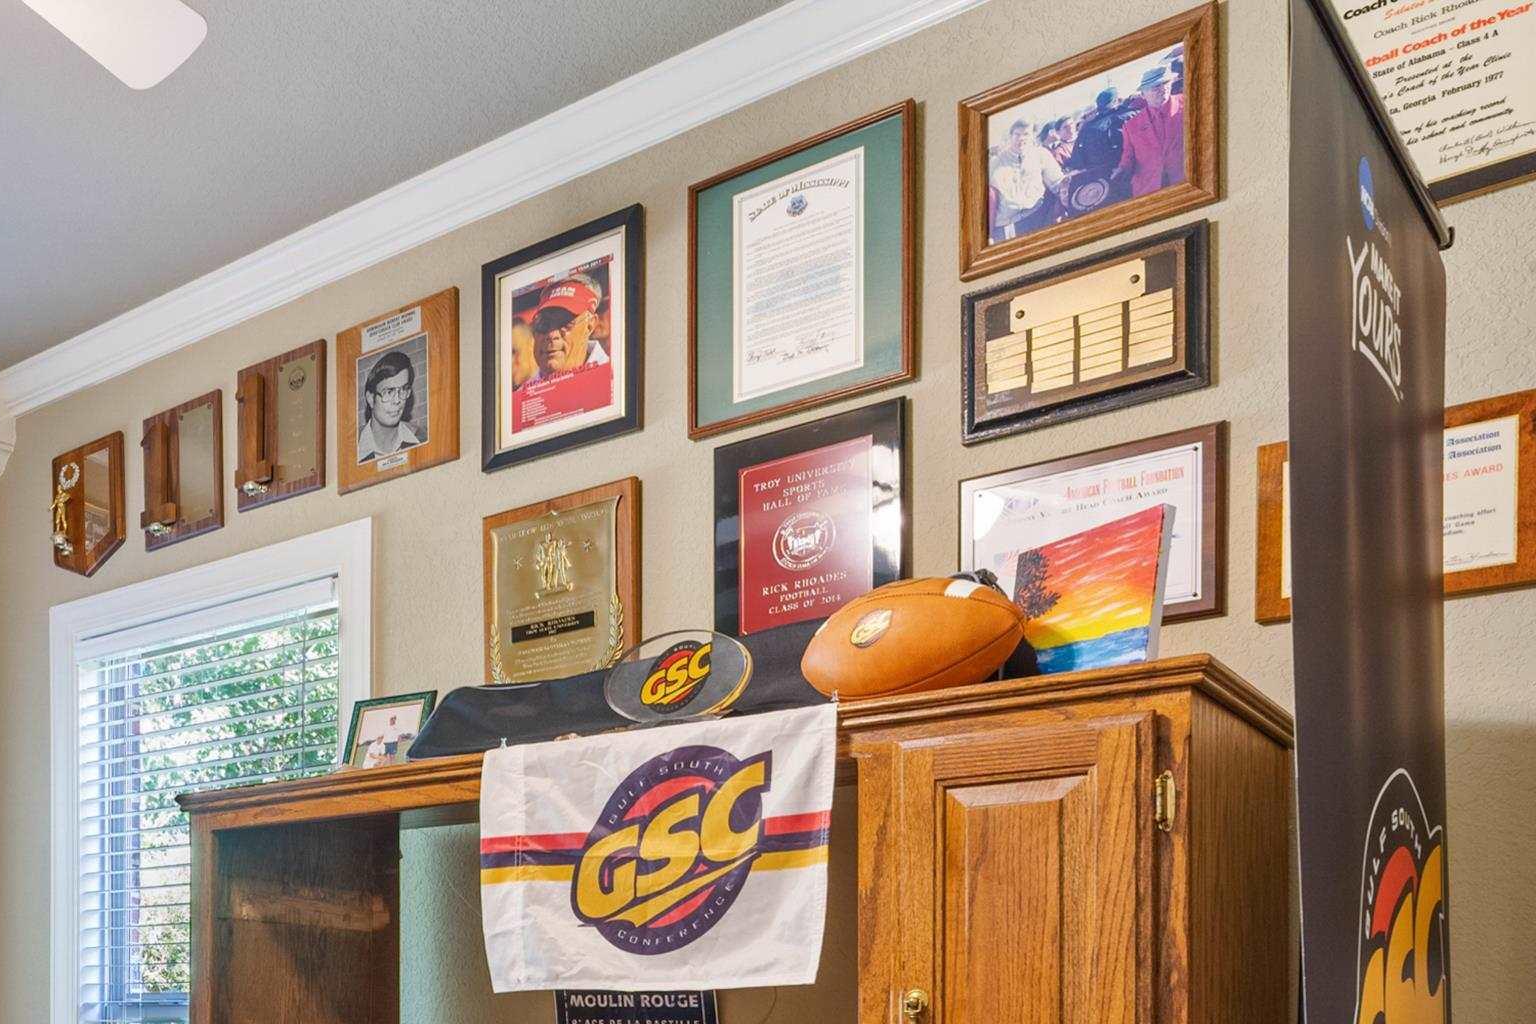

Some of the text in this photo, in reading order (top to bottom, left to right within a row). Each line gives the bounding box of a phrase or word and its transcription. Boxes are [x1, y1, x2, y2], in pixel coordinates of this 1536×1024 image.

[1373, 22, 1408, 39] Coach
[1411, 12, 1438, 26] Rick
[1402, 32, 1449, 55] Coach
[1451, 23, 1468, 38] of
[1469, 14, 1497, 31] the
[1497, 1, 1534, 22] Year
[1372, 63, 1395, 79] State
[1397, 61, 1407, 71] of
[1408, 49, 1446, 67] Alabama
[1456, 36, 1480, 50] Class
[1403, 95, 1437, 111] Georgia
[1441, 78, 1482, 98] February
[1484, 70, 1505, 84] 1977
[1346, 235, 1402, 387] YOURS
[1446, 429, 1500, 448] Association
[1448, 442, 1503, 461] Association
[753, 457, 857, 493] TROY UNIVERSITY
[1464, 462, 1504, 478] AWARD
[782, 478, 825, 498] SPORTS
[763, 497, 792, 512] HALL
[797, 492, 811, 504] OF
[762, 581, 789, 596] RICK
[779, 585, 829, 603] FOOTBALL
[768, 602, 799, 615] CLASS
[803, 598, 814, 609] OF
[640, 641, 713, 705] GSC
[657, 758, 725, 779] SOUTH
[576, 759, 766, 921] GSC
[1391, 807, 1422, 860] SOUTH
[616, 881, 736, 947] CONFERENCE
[570, 994, 699, 1008] MOULIN ROUGE
